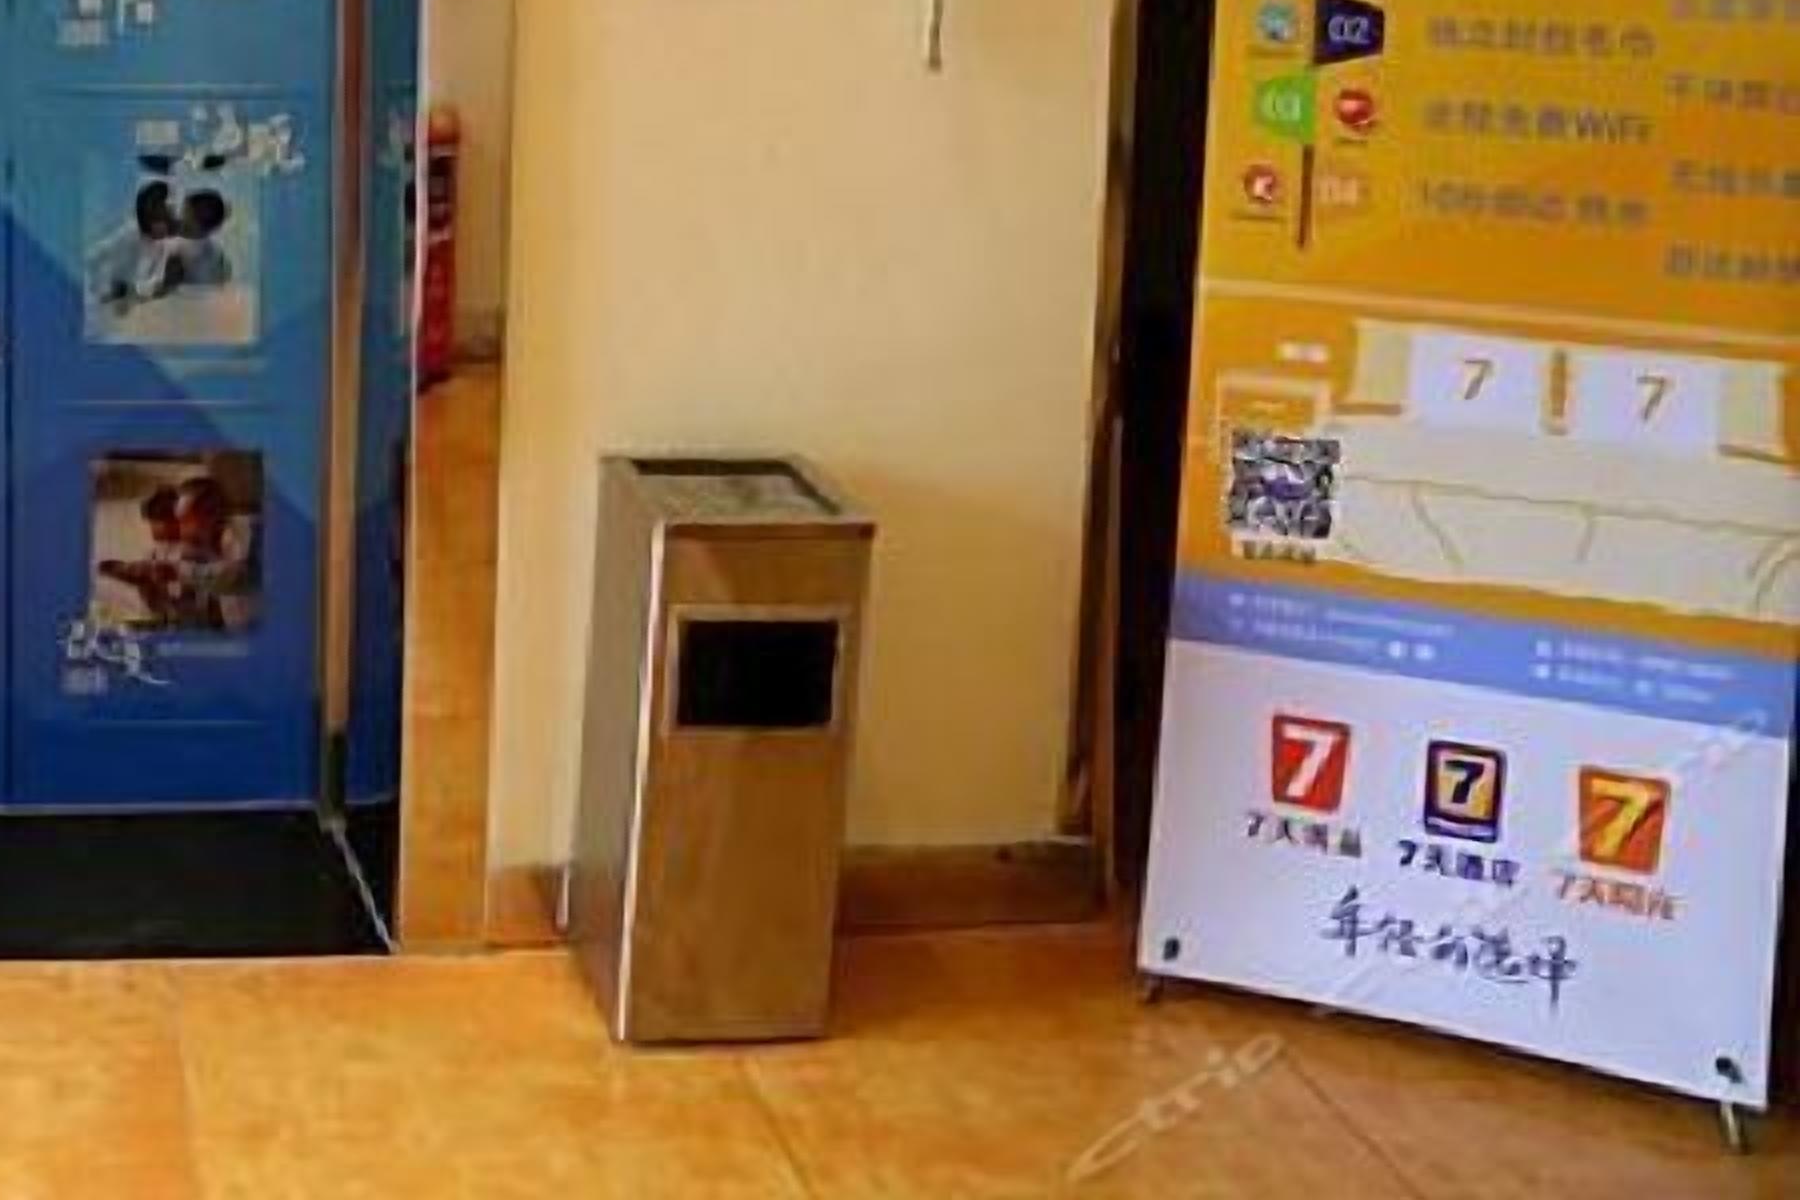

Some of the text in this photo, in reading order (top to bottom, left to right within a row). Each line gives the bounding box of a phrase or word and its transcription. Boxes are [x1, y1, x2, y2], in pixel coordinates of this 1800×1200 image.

[1281, 723, 1336, 798] 7
[1443, 759, 1485, 805] 7
[1590, 778, 1652, 857] 7
[1320, 884, 1579, 1013] 年轻的选择
